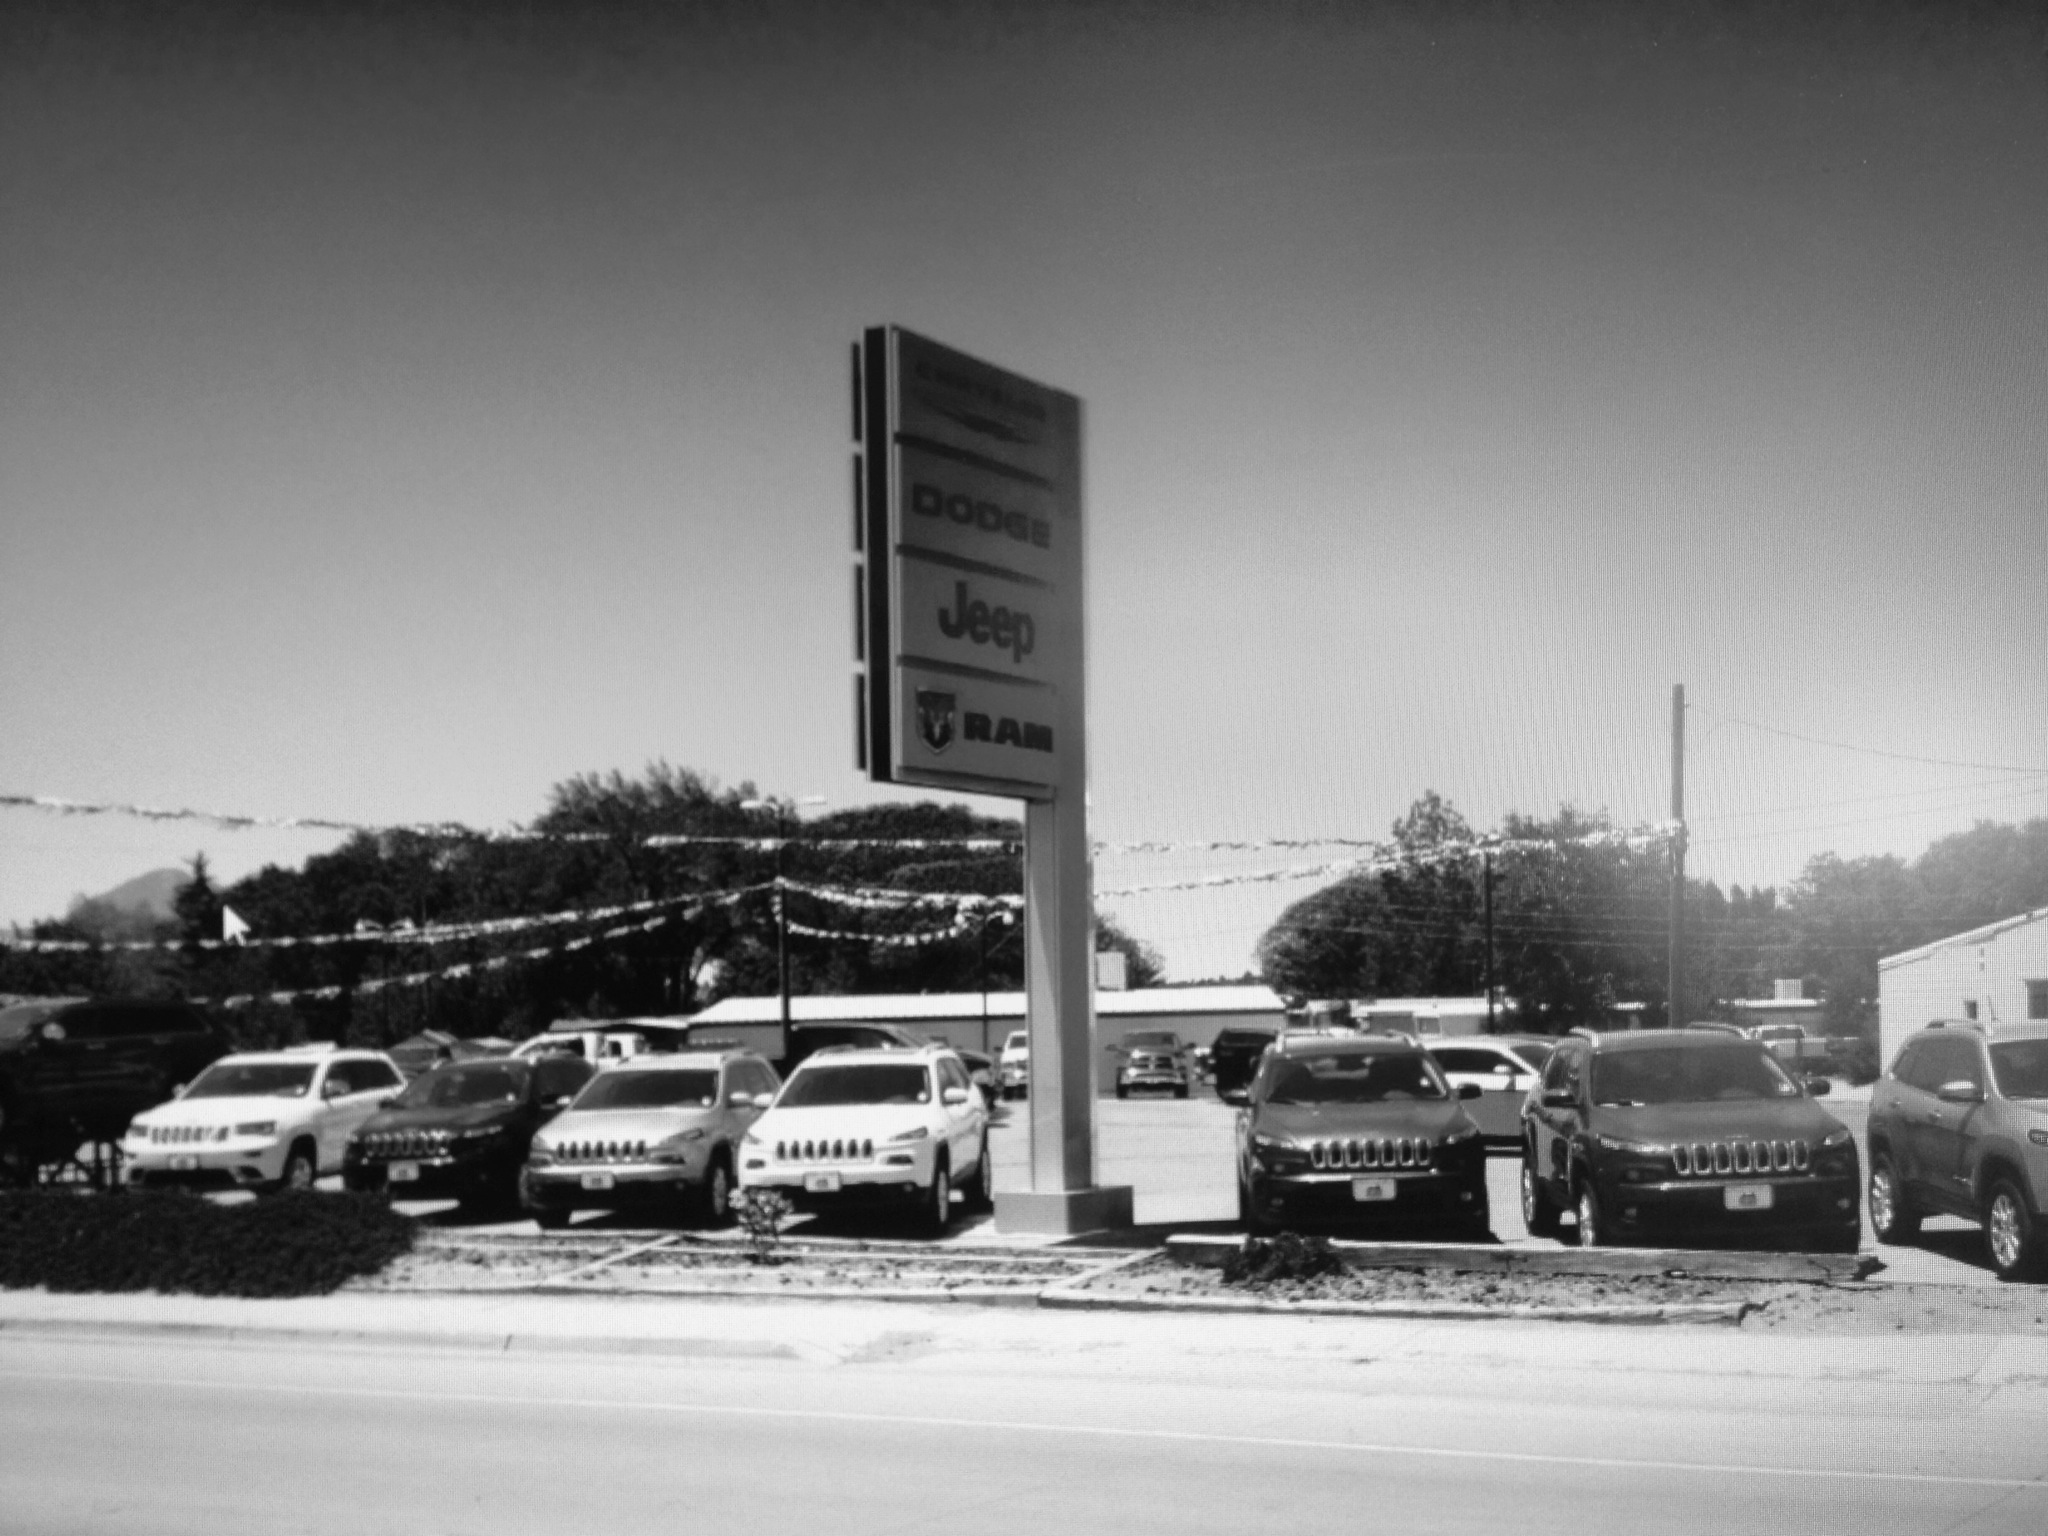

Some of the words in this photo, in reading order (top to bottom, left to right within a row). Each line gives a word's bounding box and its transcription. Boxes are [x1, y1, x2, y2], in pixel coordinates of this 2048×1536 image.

[912, 482, 1051, 549] DODGE
[938, 581, 1035, 664] Jeep
[963, 711, 1054, 753] RAM
